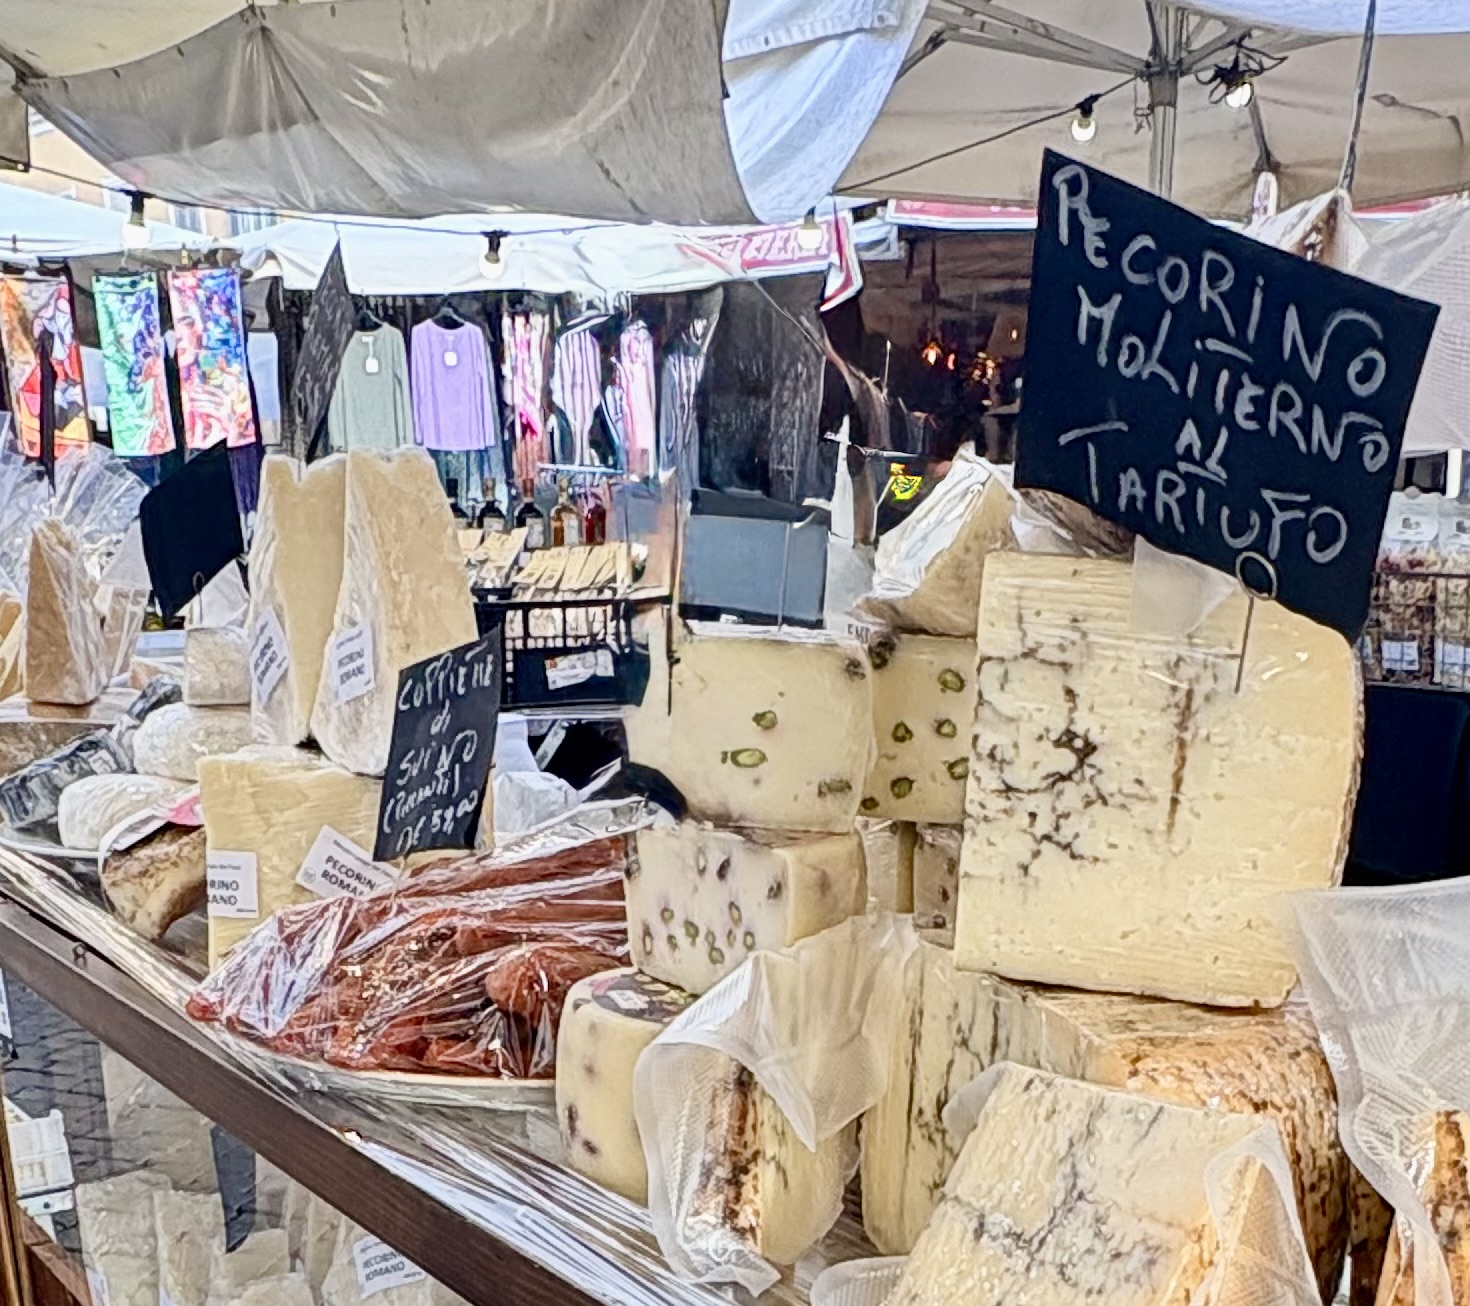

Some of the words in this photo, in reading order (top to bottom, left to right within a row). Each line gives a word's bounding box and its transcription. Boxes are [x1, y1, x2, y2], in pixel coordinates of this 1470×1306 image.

[1052, 164, 1386, 398] PECORINO
[1175, 419, 1228, 481] AL
[1058, 421, 1348, 564] TARTUFO
[209, 879, 240, 892] RINO
[325, 855, 377, 892] PECORIN
